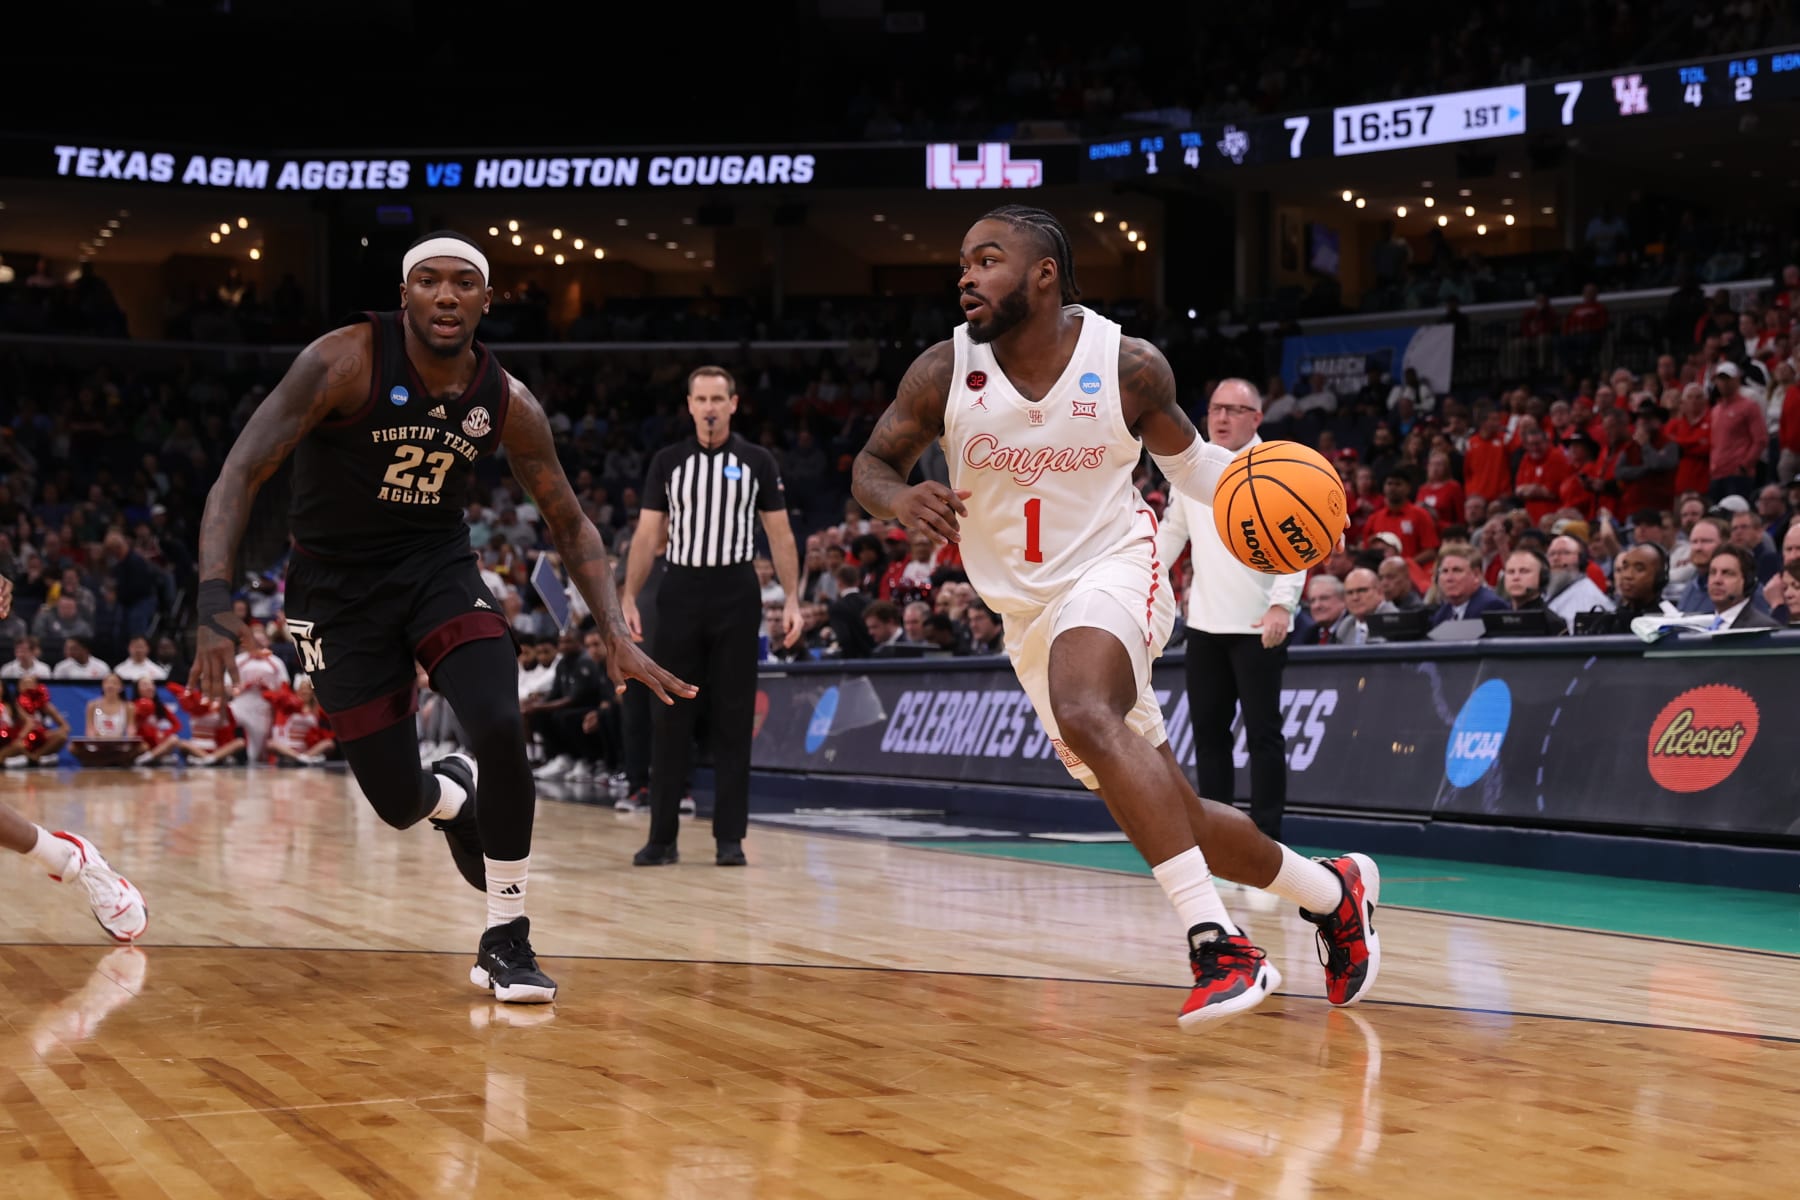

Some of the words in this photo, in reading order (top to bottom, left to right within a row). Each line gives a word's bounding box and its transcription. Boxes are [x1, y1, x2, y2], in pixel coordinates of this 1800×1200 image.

[1554, 80, 1583, 125] 7
[1683, 83, 1702, 107] 4
[1734, 77, 1752, 101] 2
[1284, 115, 1310, 158] 7
[1340, 105, 1435, 146] 16:57
[1463, 106, 1502, 130] 1ST
[54, 145, 175, 182] TEXAS
[182, 155, 269, 189] A&M
[276, 160, 411, 190] AGGIES
[425, 162, 462, 187] VS
[474, 157, 639, 188] HOUSTON
[647, 155, 815, 186] COUGARS
[1089, 141, 1131, 160] BONUS
[1146, 152, 1158, 174] 1
[1184, 147, 1200, 169] 4
[969, 375, 985, 387] 32
[467, 409, 489, 430] SEC
[1076, 404, 1092, 414] XII
[443, 432, 479, 462] TEXAS
[962, 433, 1106, 486] Cougars
[383, 444, 455, 492] 23
[377, 487, 441, 504] AGGIES
[1024, 498, 1043, 563] 1
[1278, 515, 1320, 563] NCAA
[880, 691, 1035, 757] CELEBRATES
[1653, 708, 1746, 758] Reese's
[1450, 731, 1502, 761] NCAA
